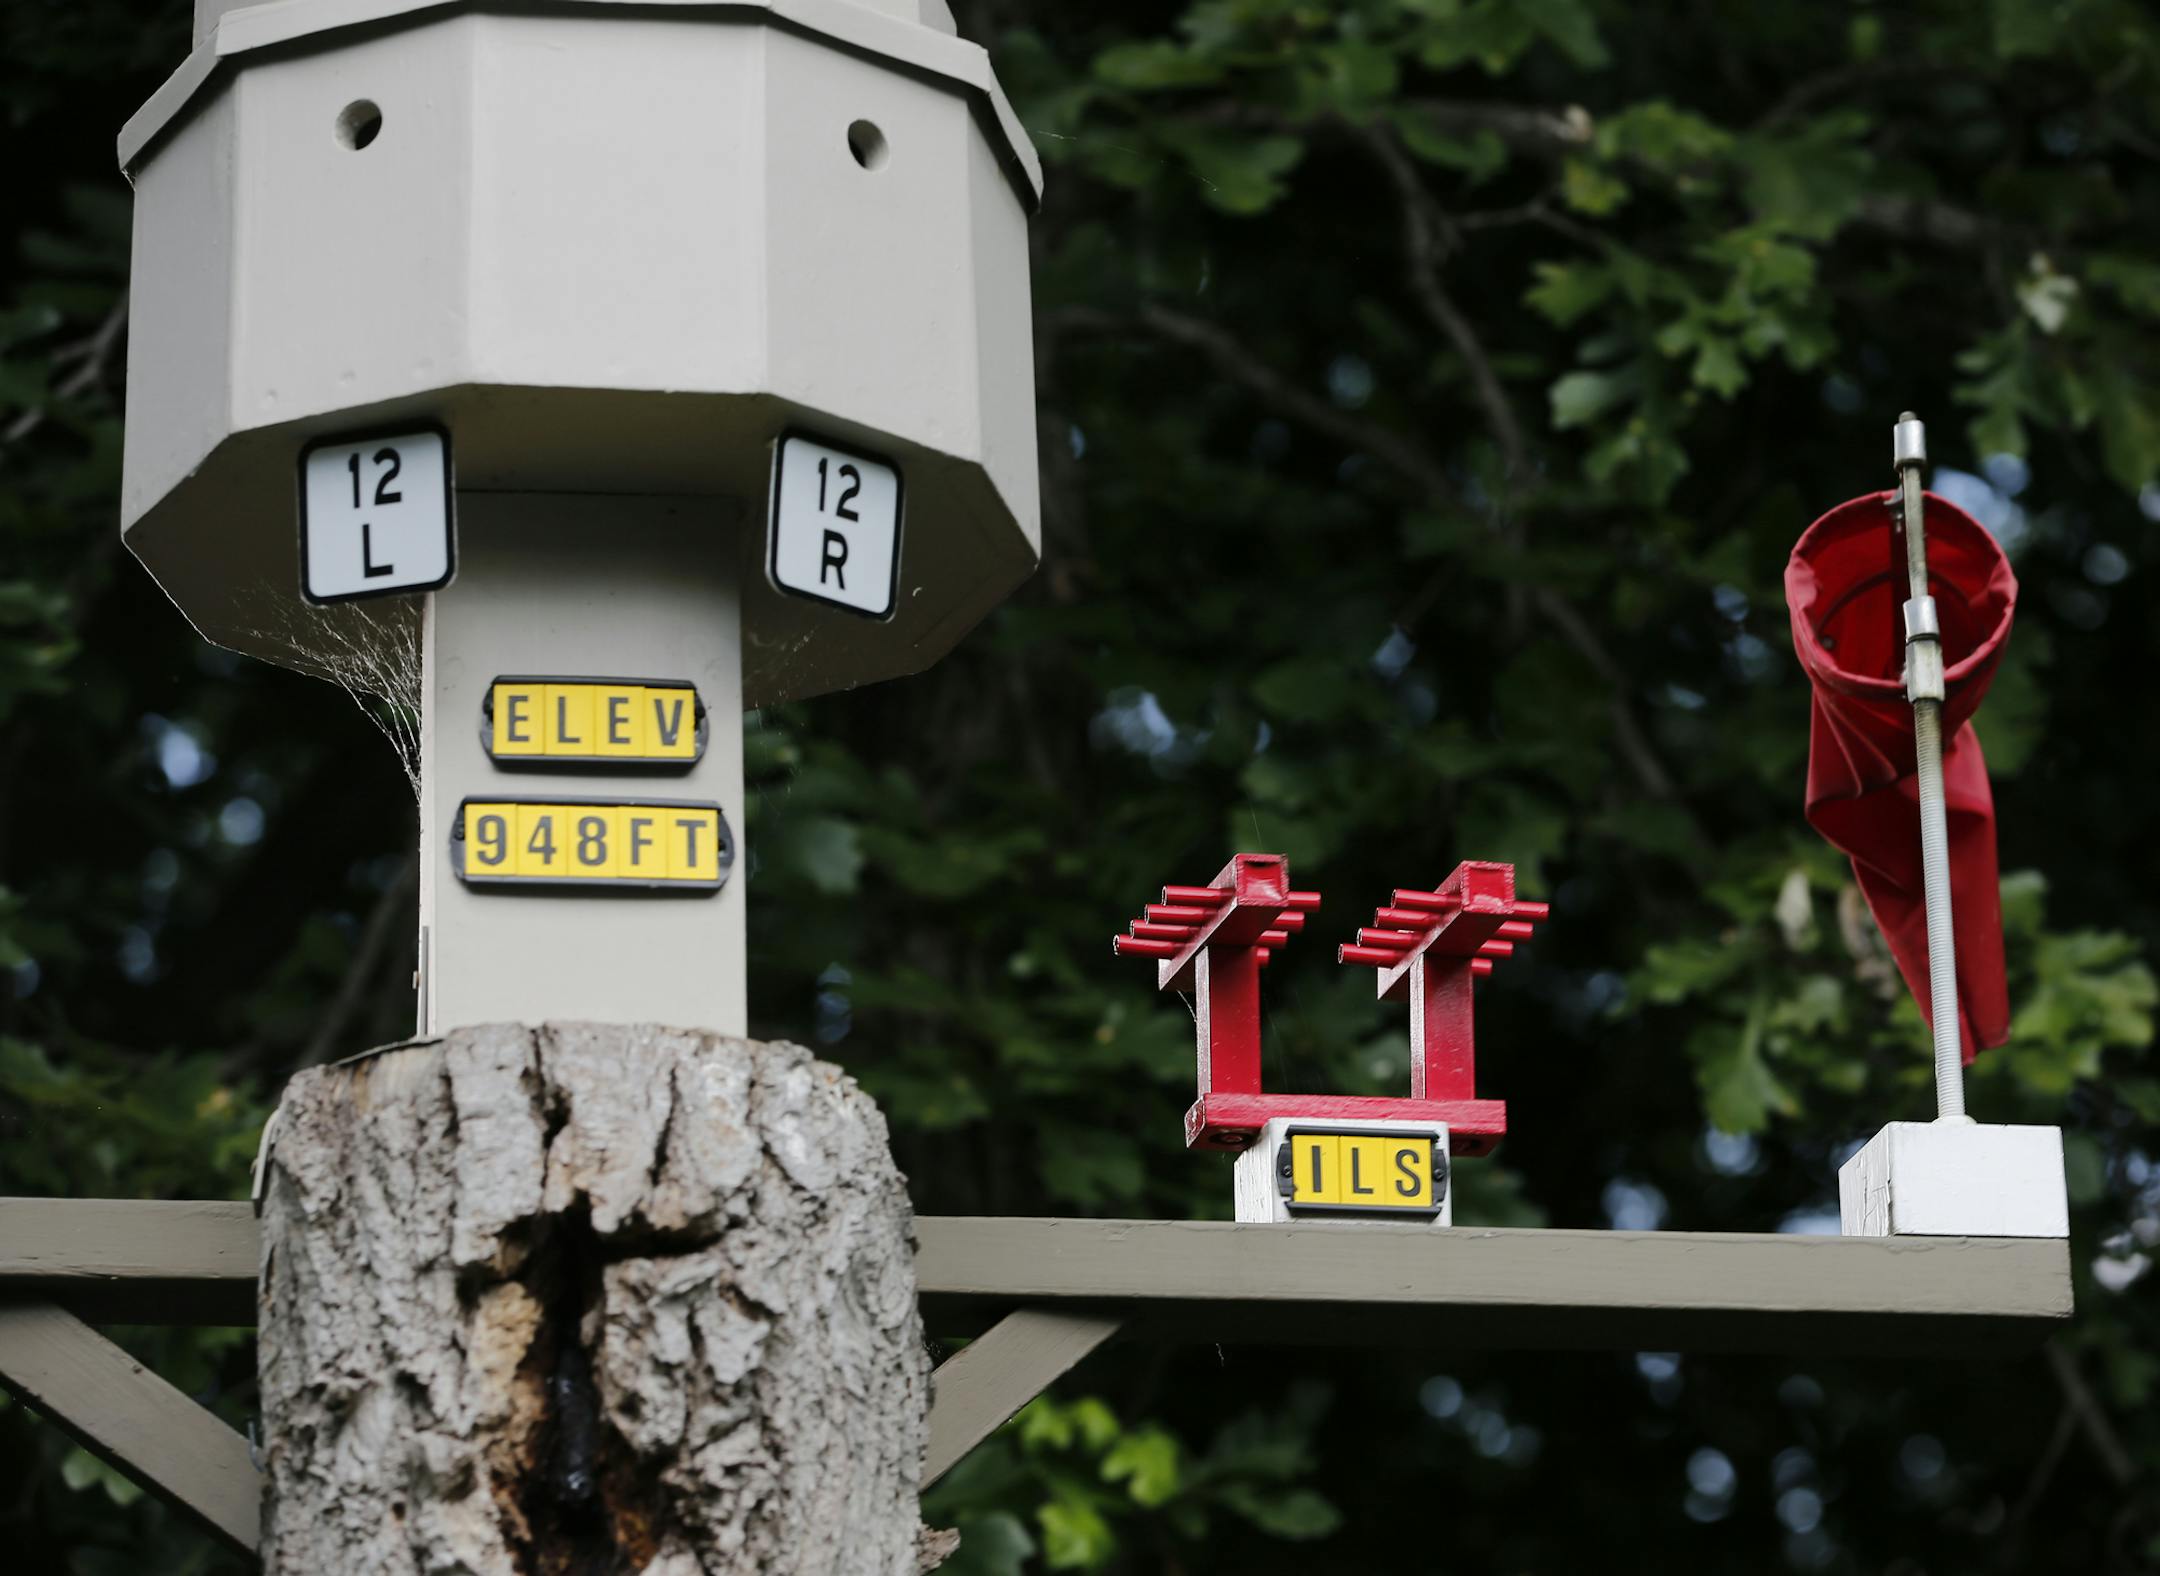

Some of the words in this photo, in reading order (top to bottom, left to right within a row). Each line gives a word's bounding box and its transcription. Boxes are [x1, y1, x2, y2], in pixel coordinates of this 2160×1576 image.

[348, 447, 403, 509] 12
[818, 457, 861, 523] 12
[361, 523, 394, 579] L
[820, 528, 849, 590] R
[507, 695, 684, 746] ELEV
[1311, 1145, 1421, 1197] ILS
